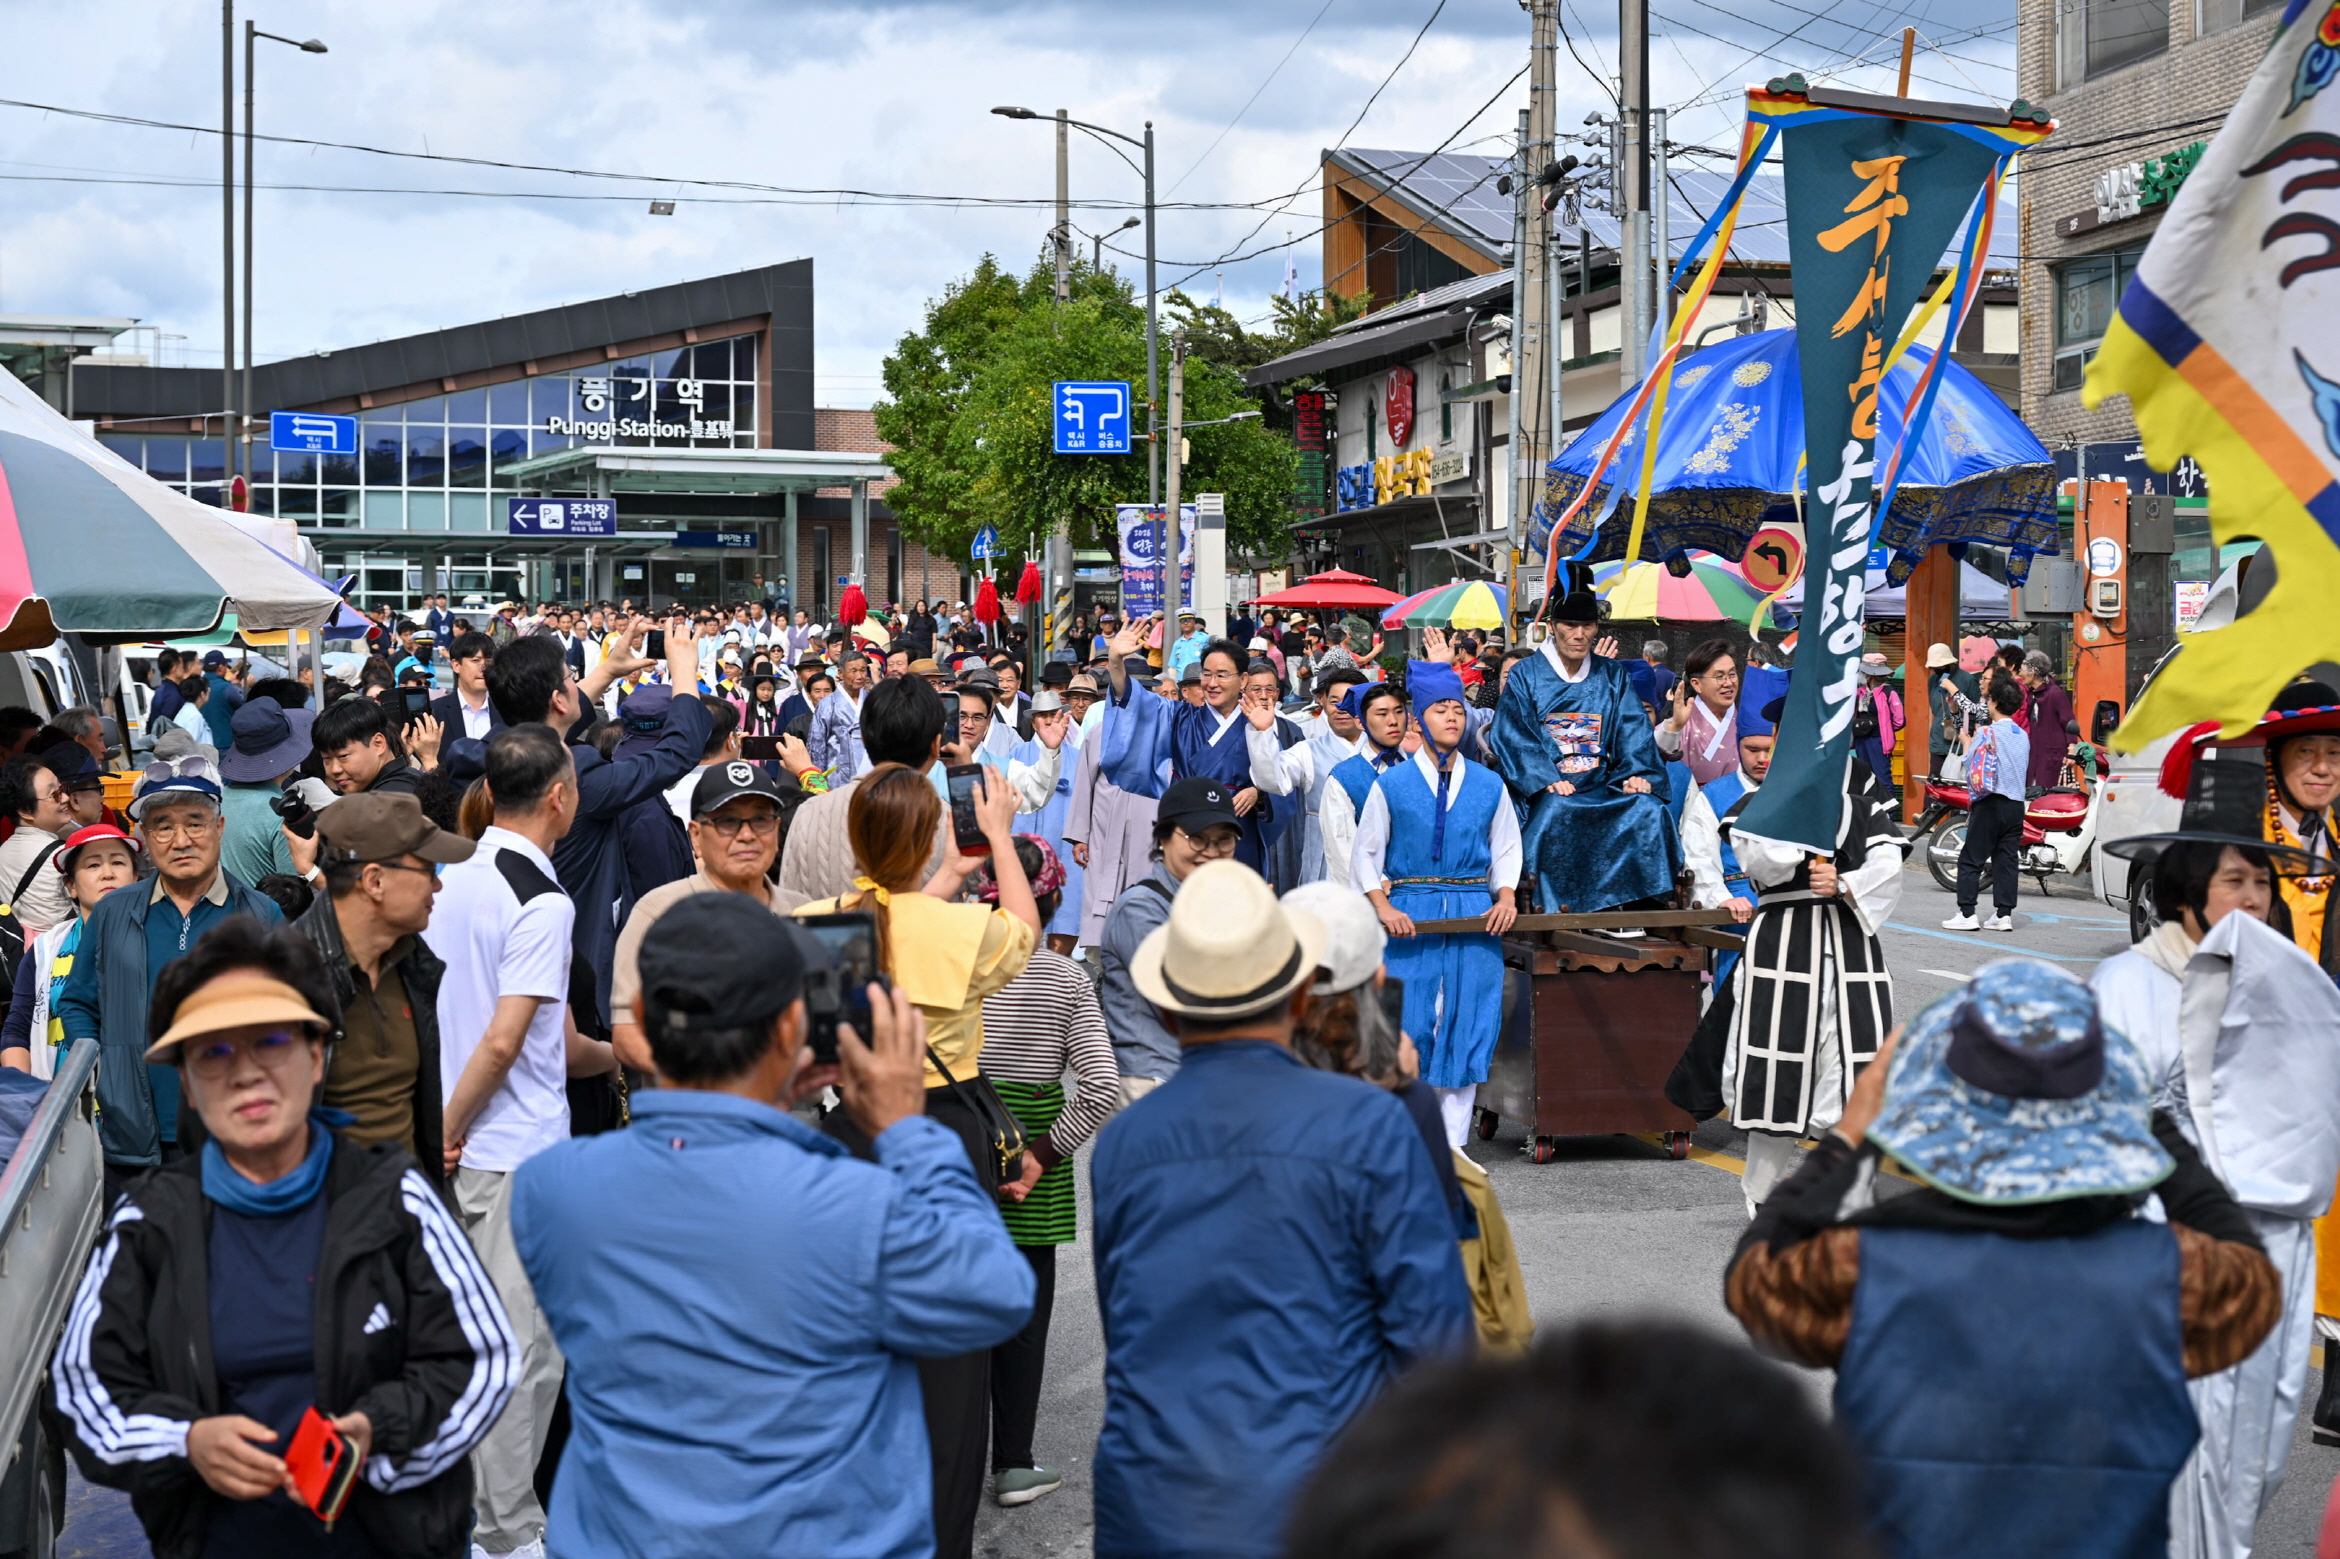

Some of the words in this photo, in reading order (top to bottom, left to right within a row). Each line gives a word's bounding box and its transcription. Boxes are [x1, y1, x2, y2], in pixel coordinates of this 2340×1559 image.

[580, 377, 704, 413] 풍기역
[550, 416, 617, 440] Punggi
[620, 418, 685, 438] Station
[1067, 431, 1085, 440] 택시
[1098, 431, 1115, 440] 버스
[1067, 440, 1086, 448] K&R
[1098, 440, 1123, 449] 승용차
[570, 503, 610, 519] 주차장
[571, 519, 591, 527] Parking
[1132, 539, 1154, 555] 영주
